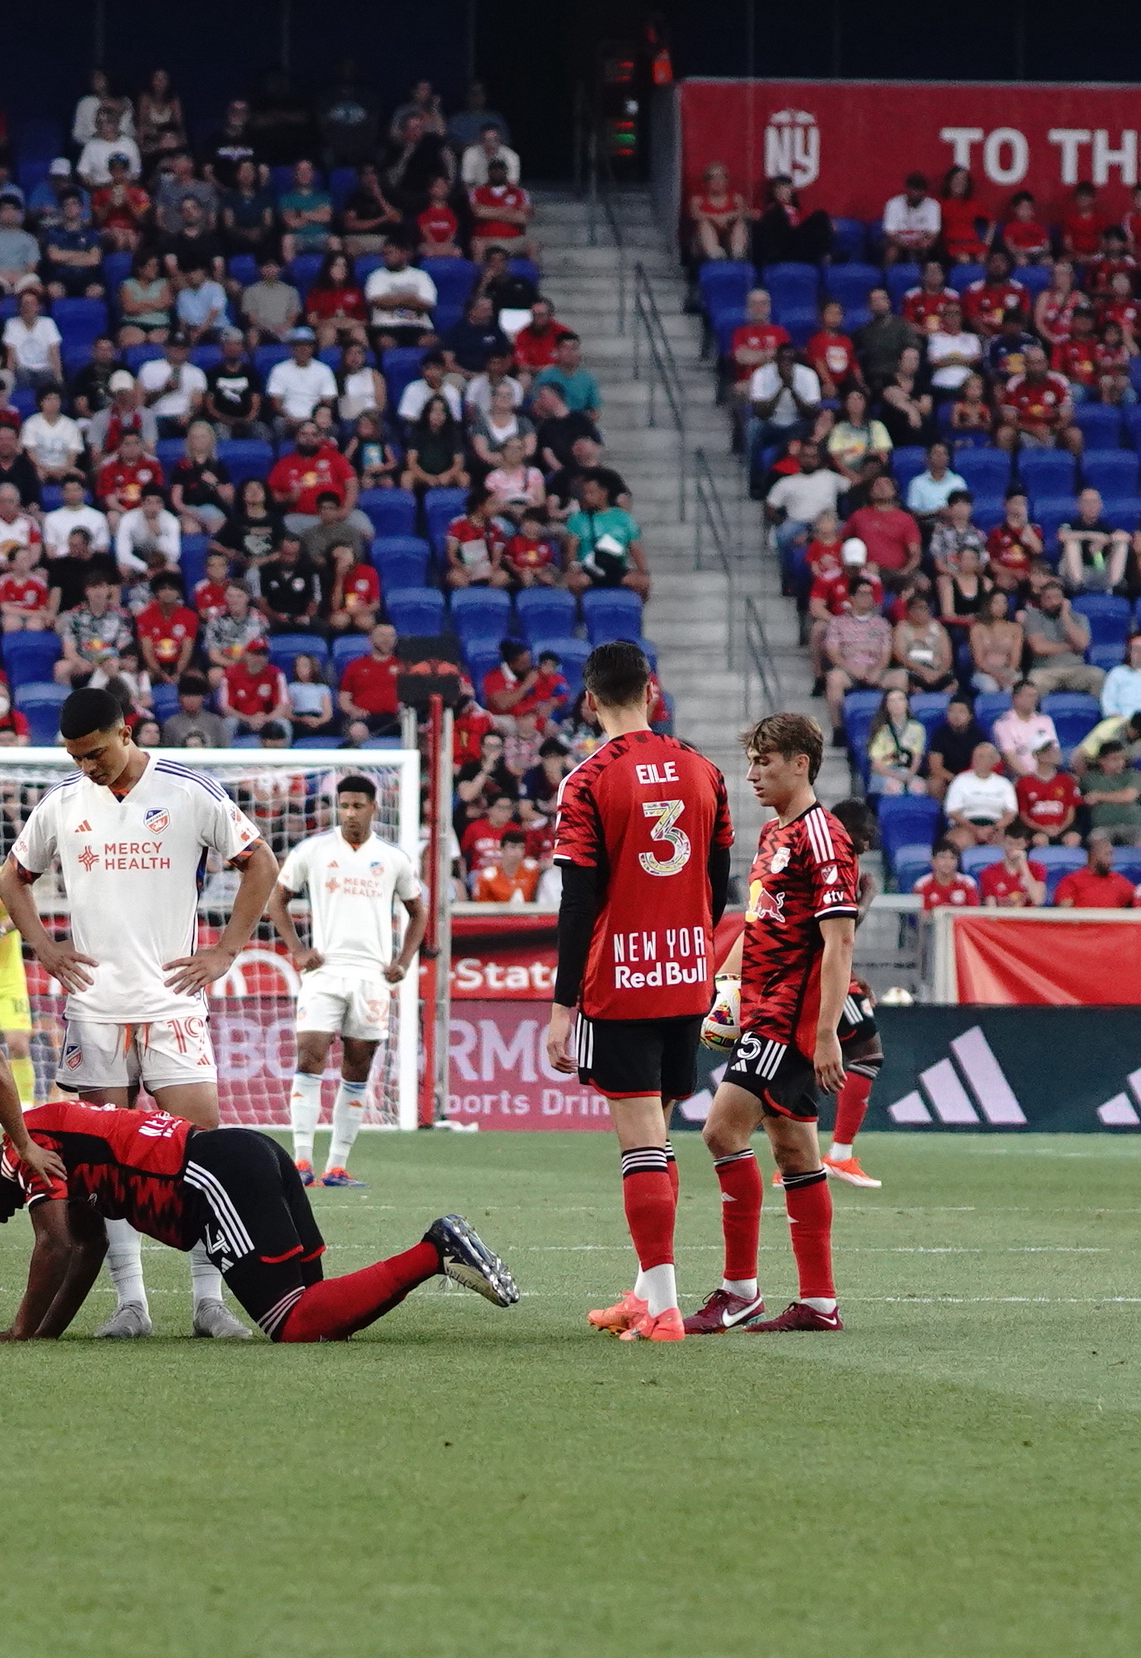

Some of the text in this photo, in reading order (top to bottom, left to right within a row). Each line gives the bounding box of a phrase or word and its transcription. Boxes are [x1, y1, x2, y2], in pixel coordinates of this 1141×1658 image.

[939, 127, 1029, 185] TO
[635, 761, 680, 785] EILE
[104, 841, 164, 855] MERCY
[638, 799, 692, 877] 3
[104, 856, 171, 870] HEALTH
[343, 876, 381, 889] MERCY
[343, 885, 383, 898] HEALTH
[613, 926, 707, 963] NEW YOR
[665, 957, 708, 985] Bull
[736, 1031, 763, 1061] 5
[541, 1088, 611, 1116] Drin
